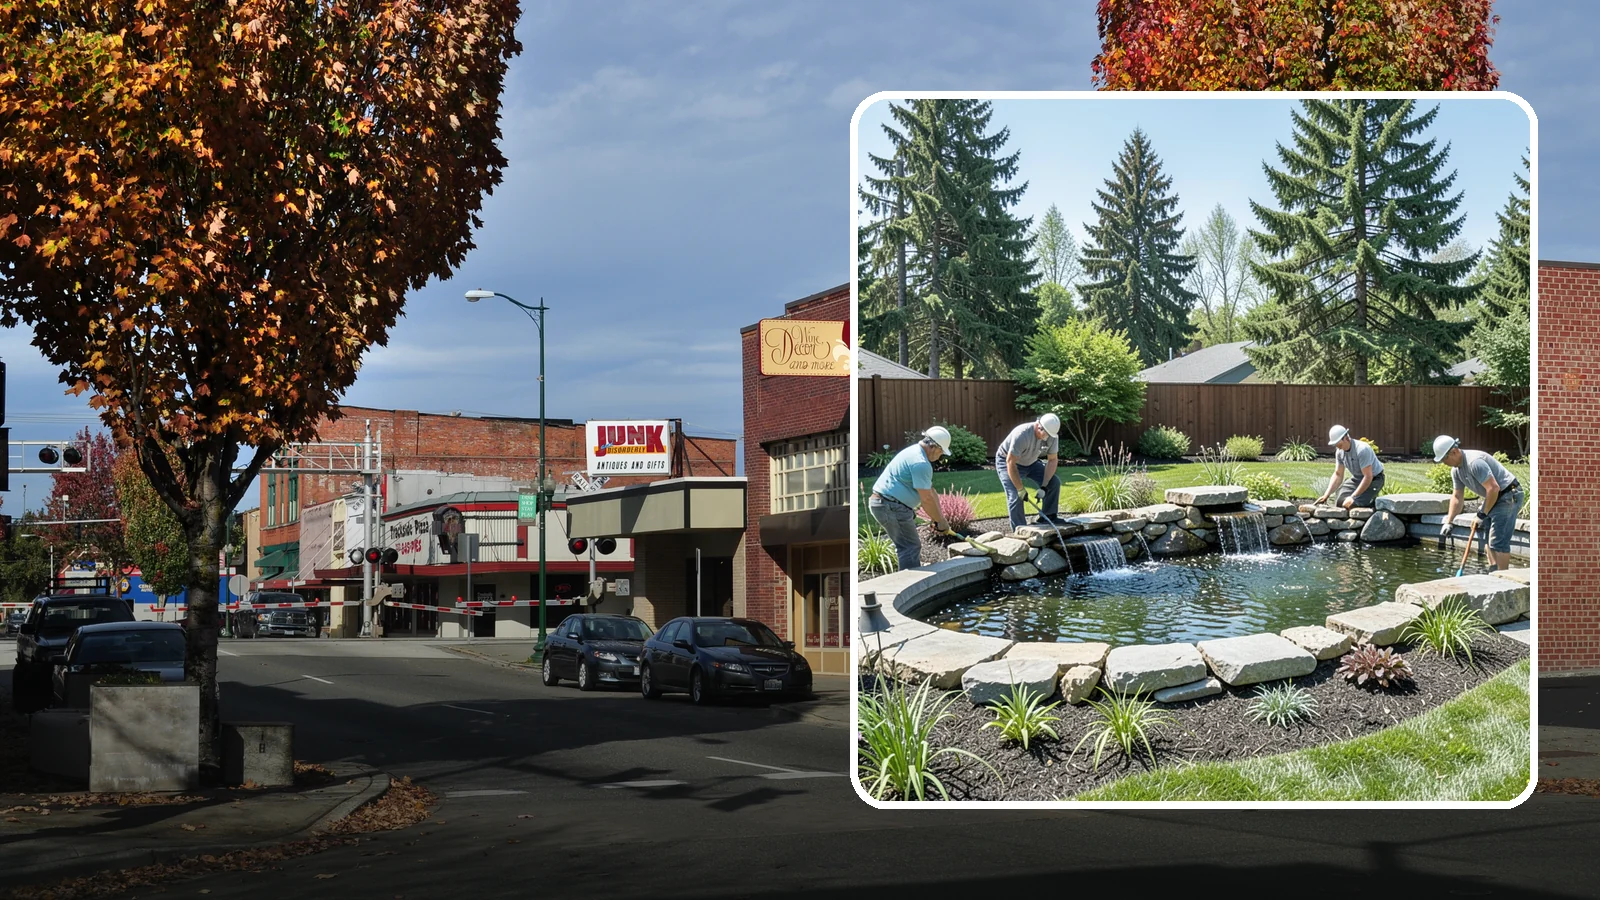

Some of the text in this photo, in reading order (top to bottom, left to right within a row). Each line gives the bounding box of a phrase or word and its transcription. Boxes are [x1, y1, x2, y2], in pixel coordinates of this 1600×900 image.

[595, 425, 665, 457] JUNK
[606, 446, 645, 454] DISORDERLY
[596, 460, 665, 470] ANTIQUES AND GIFTS
[390, 519, 429, 540] Trackside Pizza
